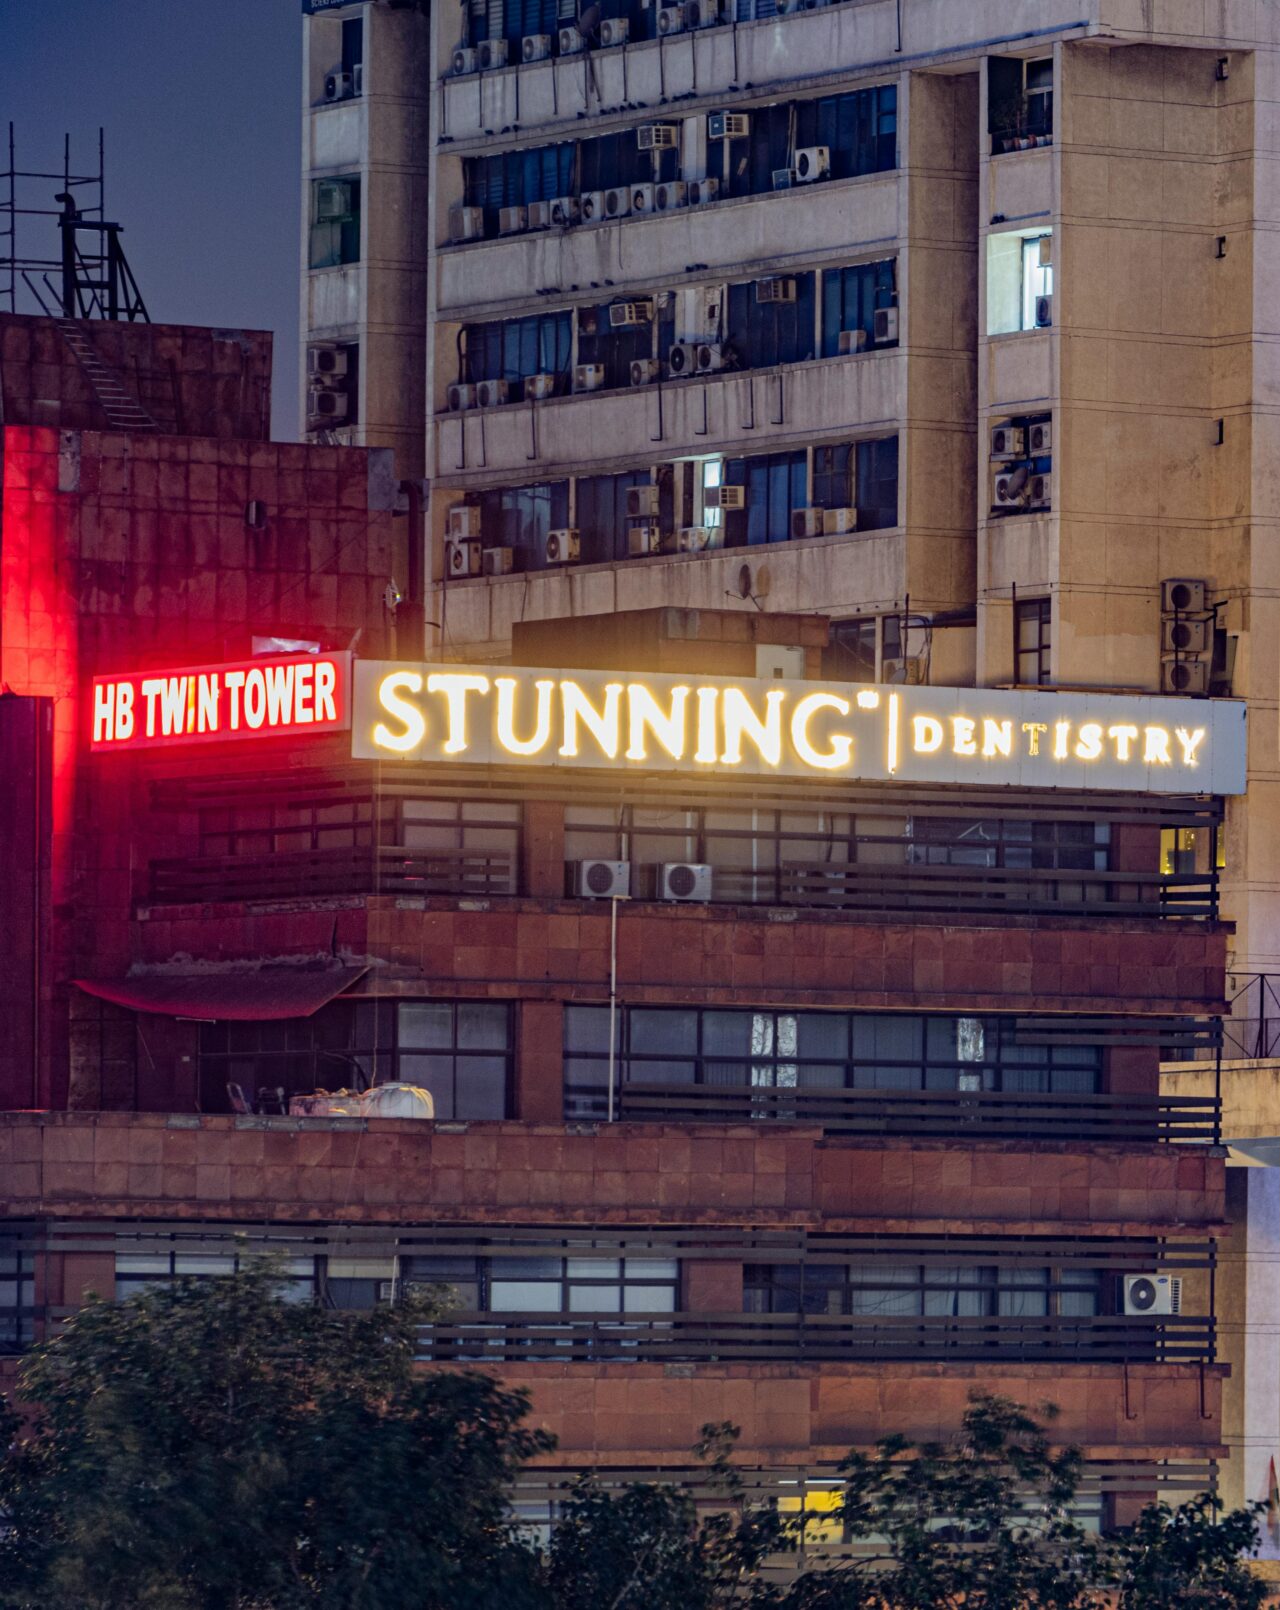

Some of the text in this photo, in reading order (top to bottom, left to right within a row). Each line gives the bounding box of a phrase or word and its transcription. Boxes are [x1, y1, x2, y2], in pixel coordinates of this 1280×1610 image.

[93, 661, 337, 742] HB TWIN TOWER
[913, 715, 1206, 765] DENTISTRY
